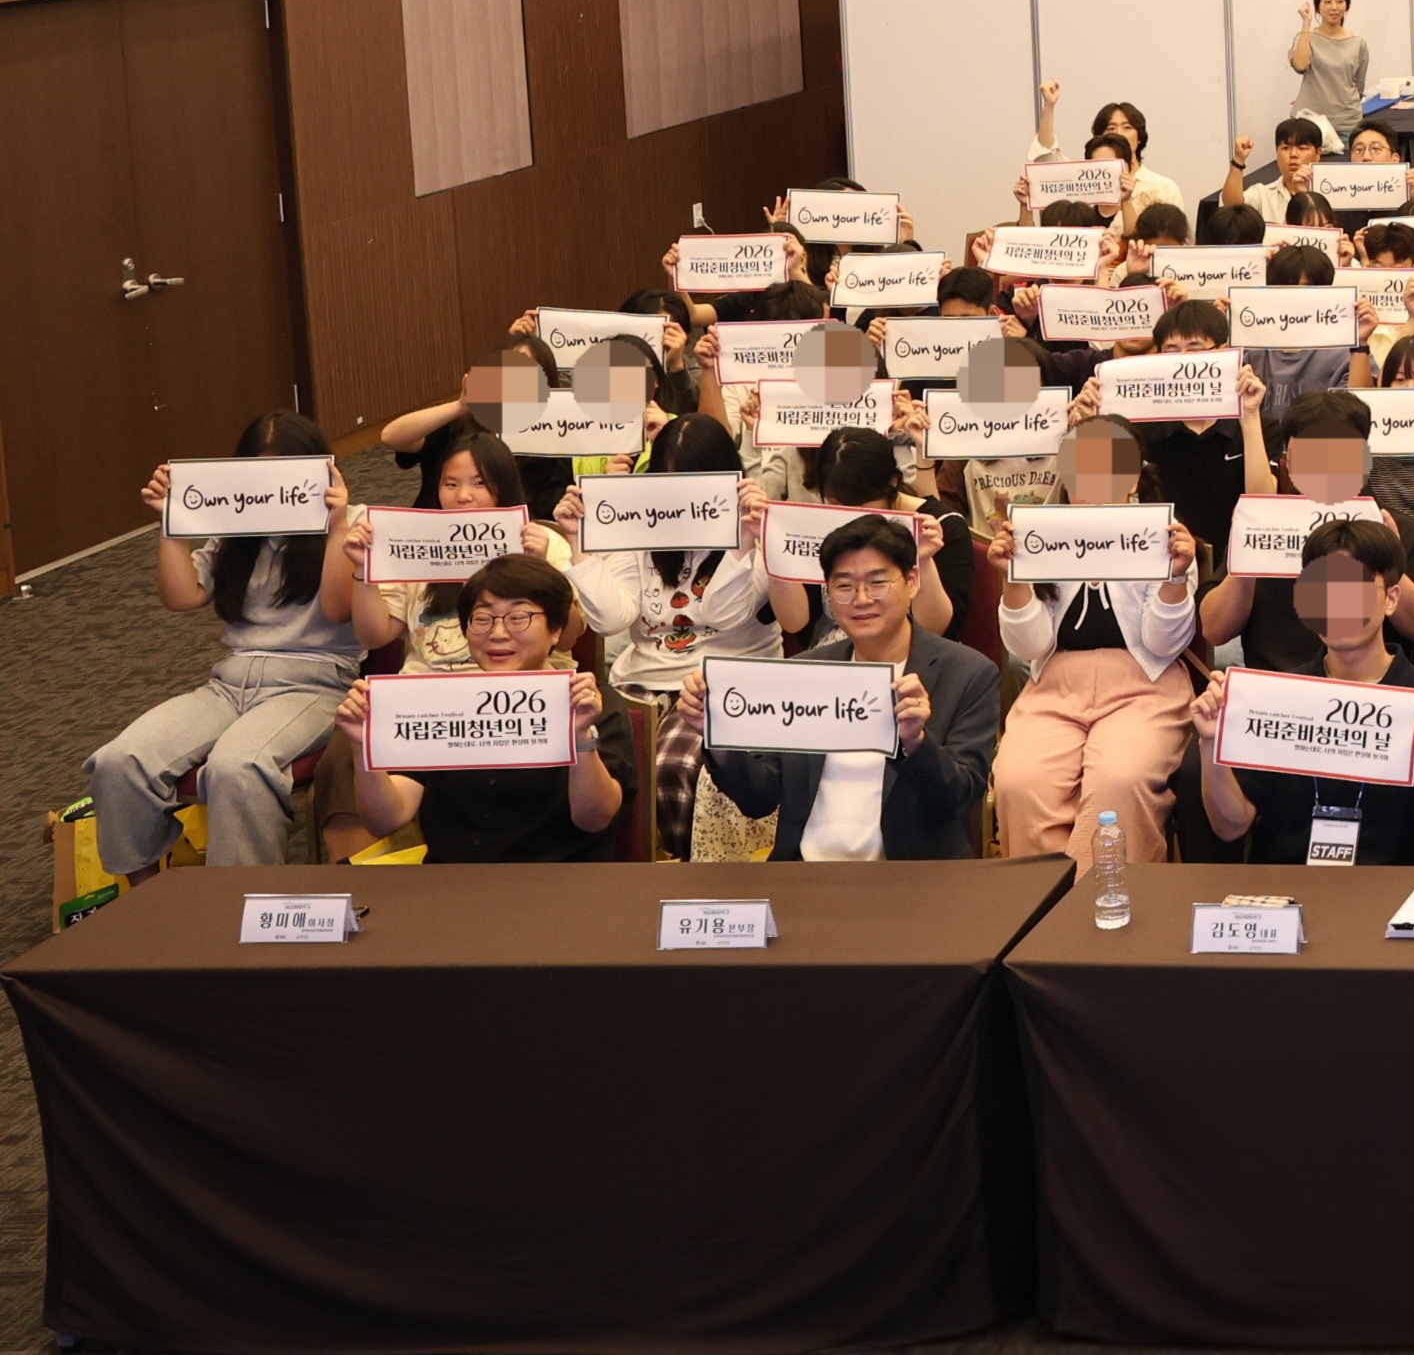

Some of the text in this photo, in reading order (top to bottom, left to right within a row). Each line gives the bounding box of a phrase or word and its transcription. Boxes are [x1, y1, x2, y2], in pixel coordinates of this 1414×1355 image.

[797, 206, 884, 229] Own your life
[734, 244, 774, 259] 2026
[689, 260, 773, 274] 자립준비청년의 날
[1239, 306, 1339, 332] Own your life
[1172, 362, 1222, 380] 2026
[1116, 381, 1222, 399] 자립준비청년의 날
[182, 484, 310, 514] Own your life
[595, 499, 720, 529] Own your life
[476, 690, 546, 715] 2026
[722, 686, 869, 727] Own your life
[1325, 699, 1393, 729] 2026
[394, 716, 547, 741] 자립준비청년의 날
[1245, 718, 1391, 751] 자립준비청년의 날
[1311, 844, 1353, 860] STAFF
[260, 911, 307, 929] 황미애
[679, 917, 725, 934] 유기용
[1211, 922, 1277, 939] 김도영 대표
